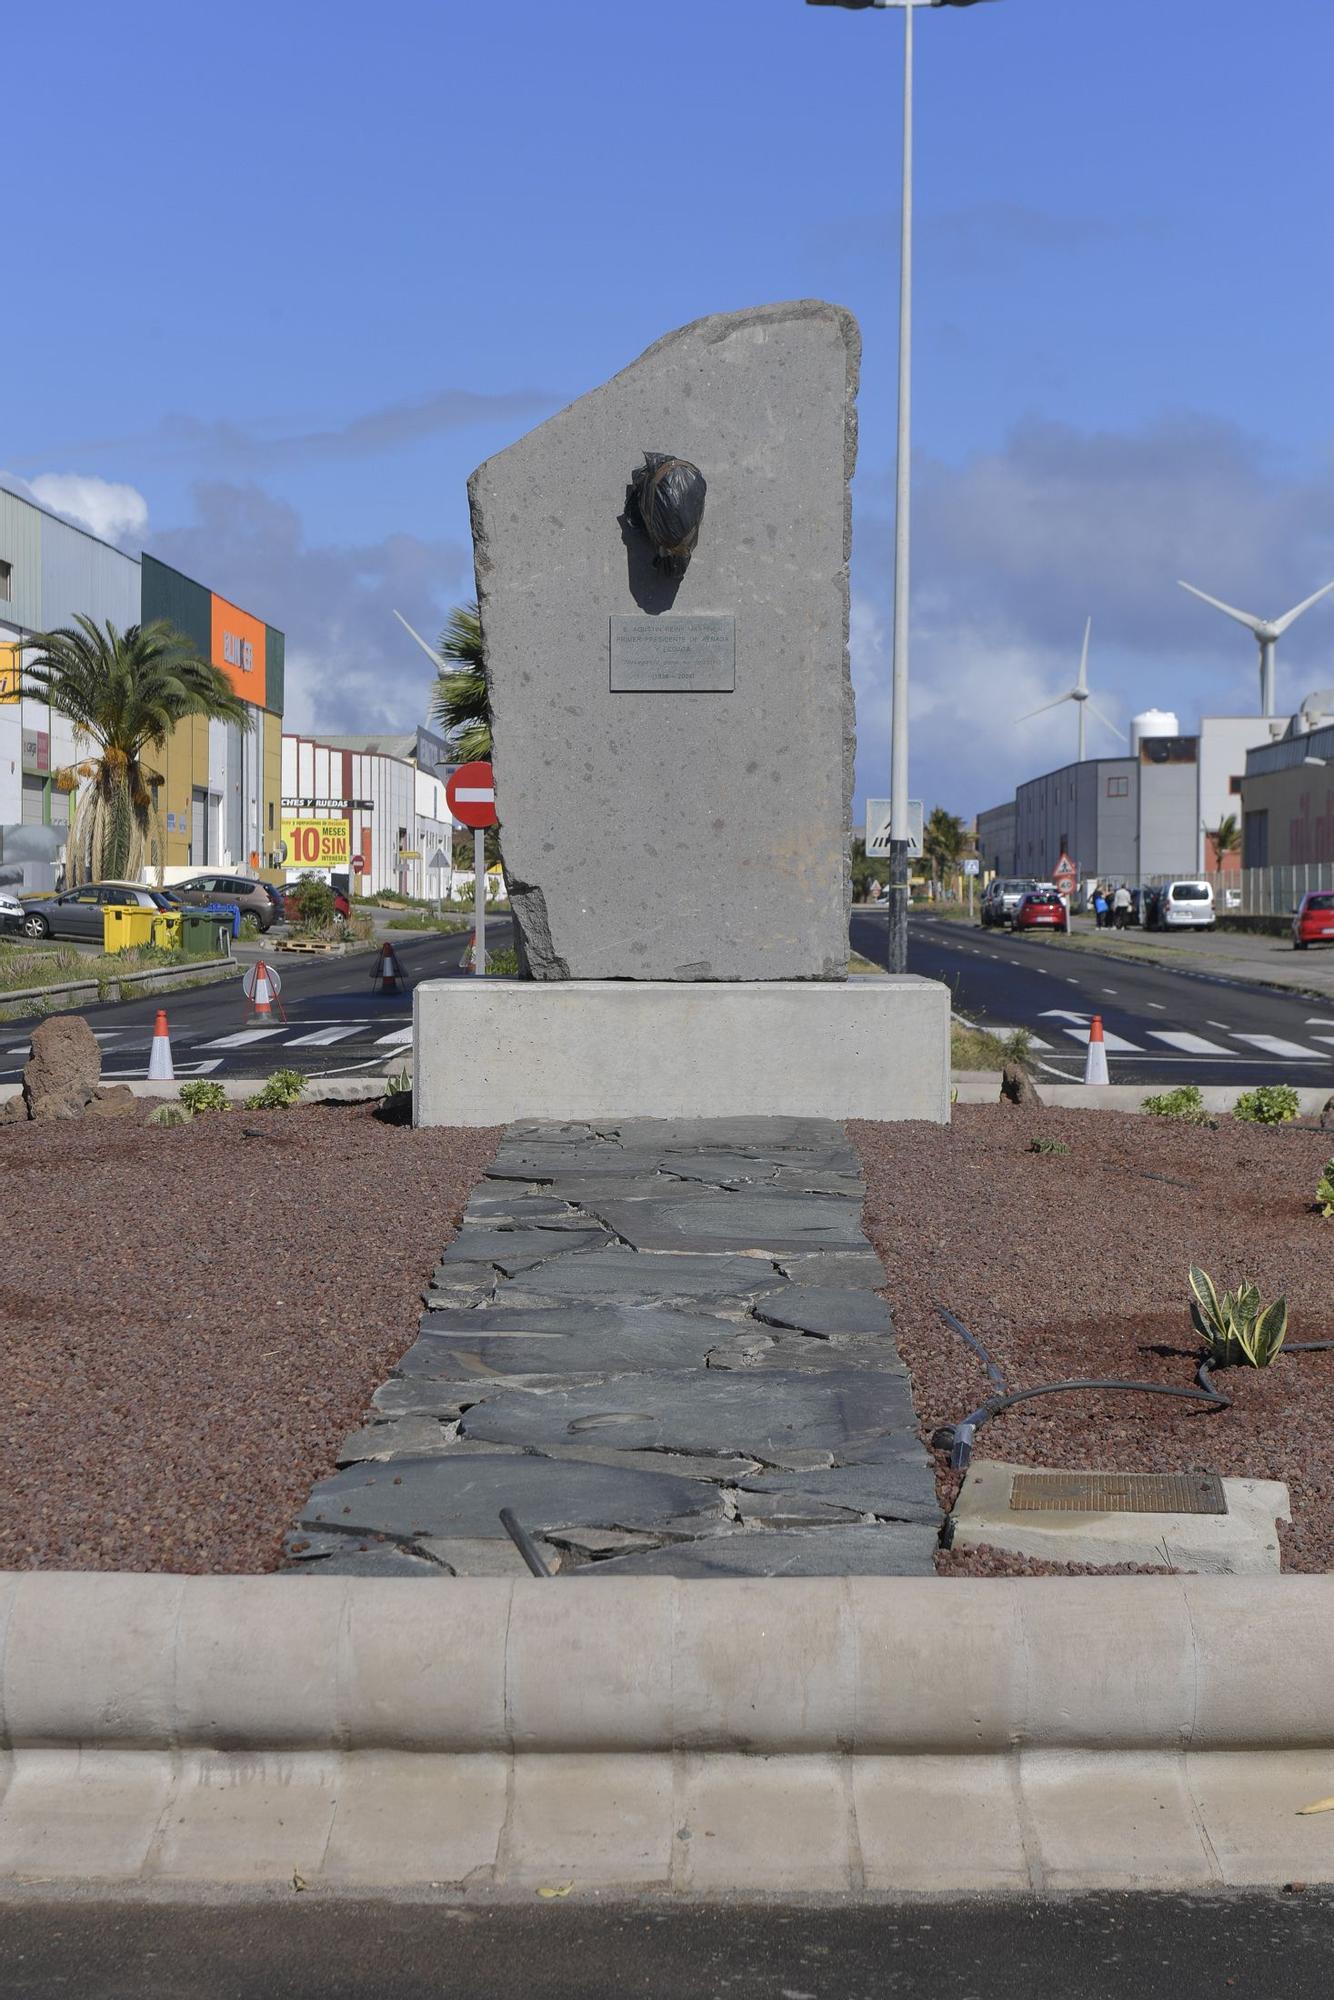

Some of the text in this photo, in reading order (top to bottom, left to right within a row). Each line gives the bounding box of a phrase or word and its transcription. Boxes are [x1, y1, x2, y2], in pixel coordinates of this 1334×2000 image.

[322, 827, 346, 837] MESES
[290, 827, 320, 862] 10
[321, 837, 346, 855] SIN
